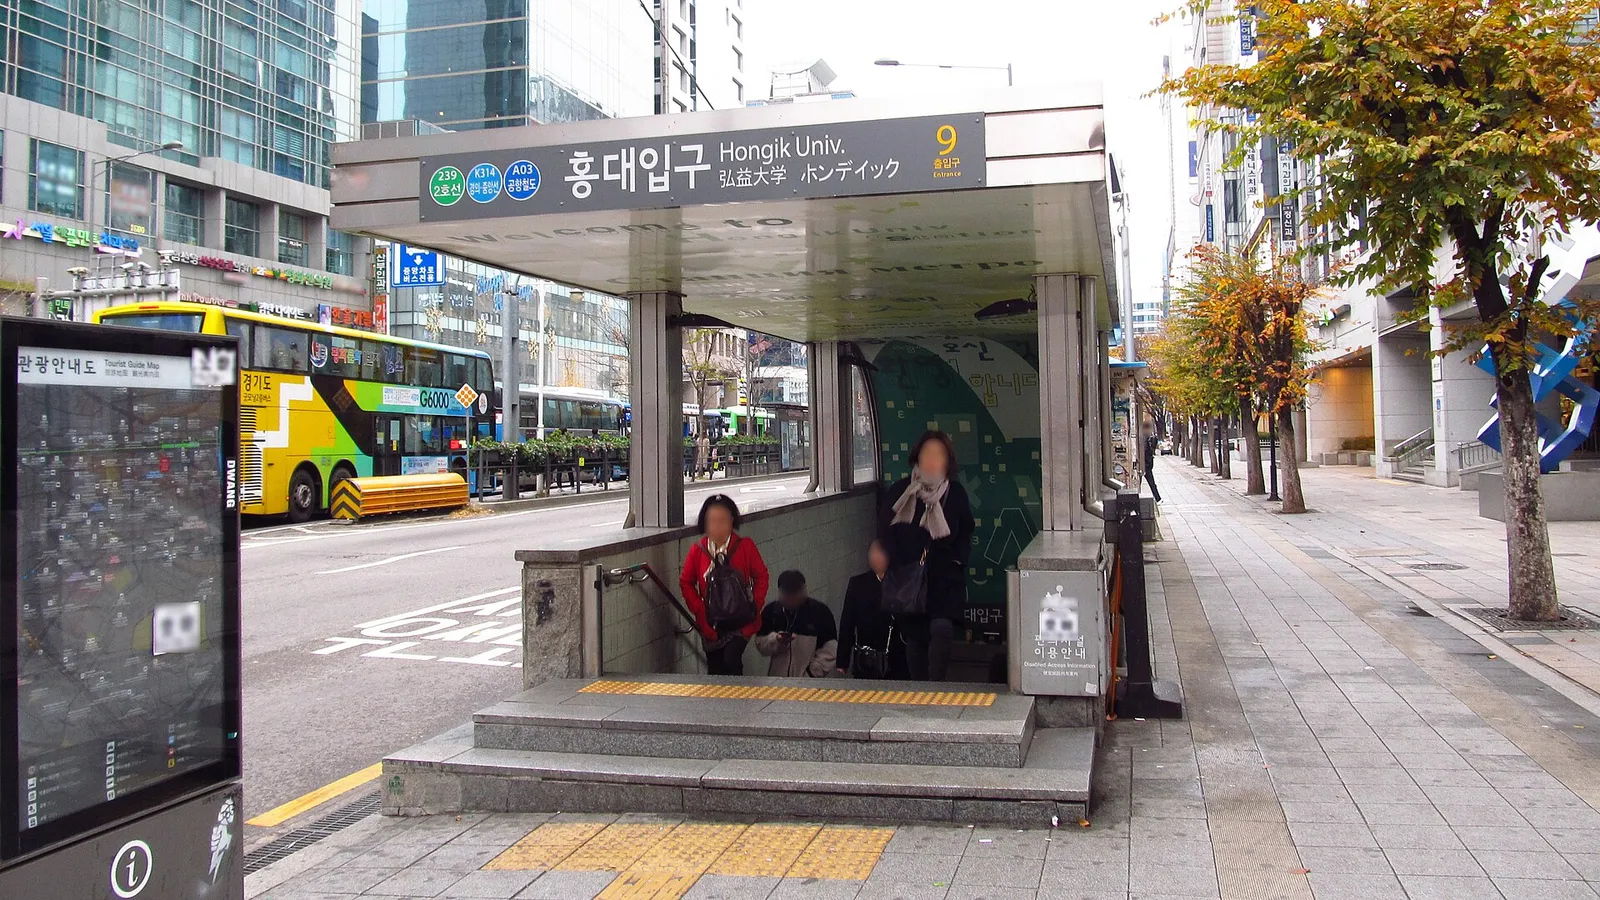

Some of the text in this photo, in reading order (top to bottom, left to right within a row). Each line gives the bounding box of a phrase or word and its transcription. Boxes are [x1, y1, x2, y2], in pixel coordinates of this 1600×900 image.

[936, 124, 958, 156] 9
[719, 134, 845, 164] Hongik Univ.
[512, 164, 533, 176] A03
[933, 157, 961, 170] 출입구
[438, 170, 457, 181] 239
[474, 168, 496, 178] K314
[564, 143, 711, 199] 홍대입구
[719, 163, 787, 188] 弘益大学
[933, 170, 961, 178] Entrance
[433, 184, 462, 198] 2호선
[507, 177, 537, 192] 공항철도
[723, 216, 793, 230] to
[375, 253, 386, 288] 산부인과
[403, 266, 435, 276] 중앙차로
[403, 274, 435, 283] 버스전용
[18, 355, 97, 375] 관광안내도
[104, 358, 127, 369] Tourist
[128, 360, 146, 369] Guide
[243, 373, 272, 392] 경기도
[419, 389, 450, 410] G6000
[226, 460, 236, 509] DWANG
[1034, 646, 1086, 660] 이용안내
[1023, 660, 1047, 668] Disabled
